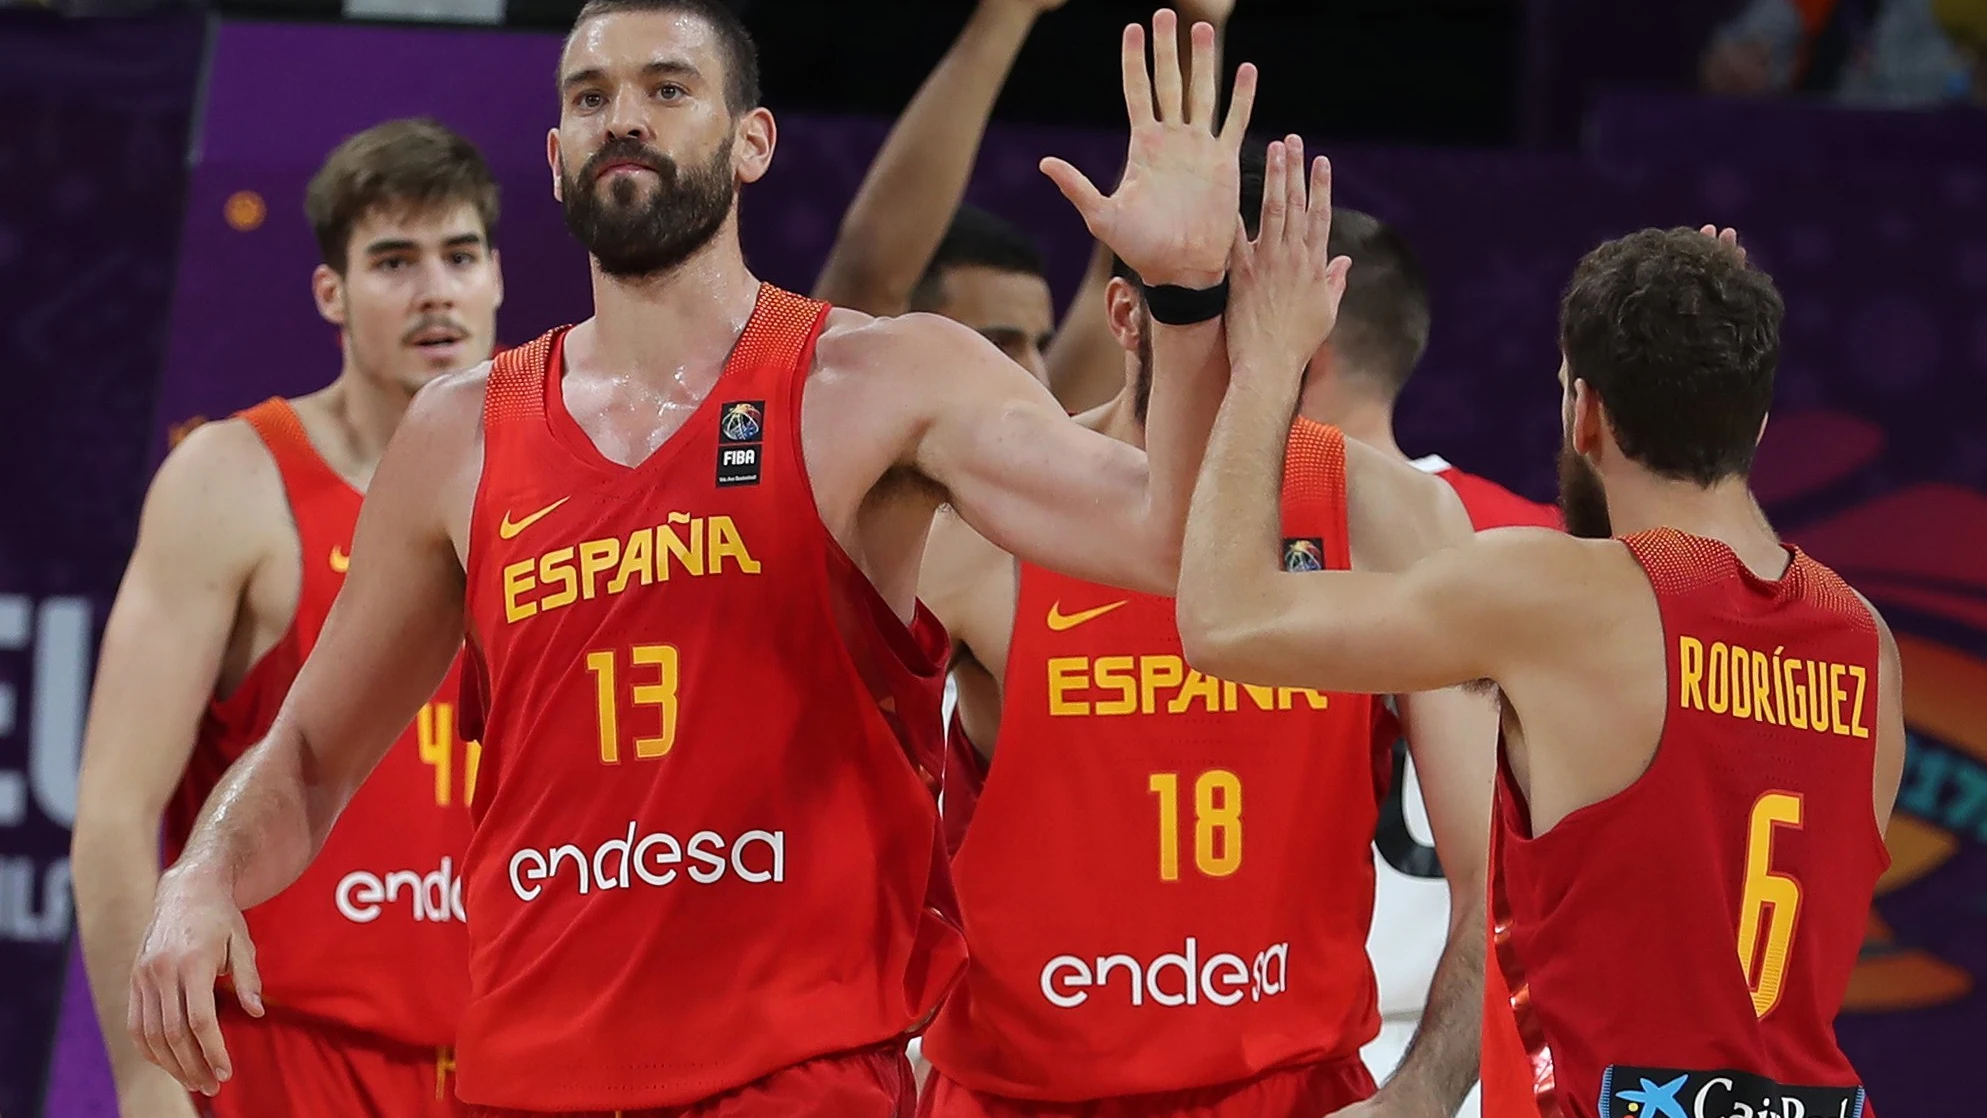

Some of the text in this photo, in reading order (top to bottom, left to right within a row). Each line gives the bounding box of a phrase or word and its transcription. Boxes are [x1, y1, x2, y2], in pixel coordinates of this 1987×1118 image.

[723, 449, 755, 466] FIBA
[503, 511, 761, 623] ESPAÑA
[586, 644, 679, 763] 13
[1680, 635, 1869, 739] RODRÍGUEZ
[417, 702, 481, 809] 4
[509, 821, 785, 901] endesa
[1149, 769, 1243, 881] 18
[1737, 789, 1803, 1019] 6
[1040, 937, 1289, 1008] endesa
